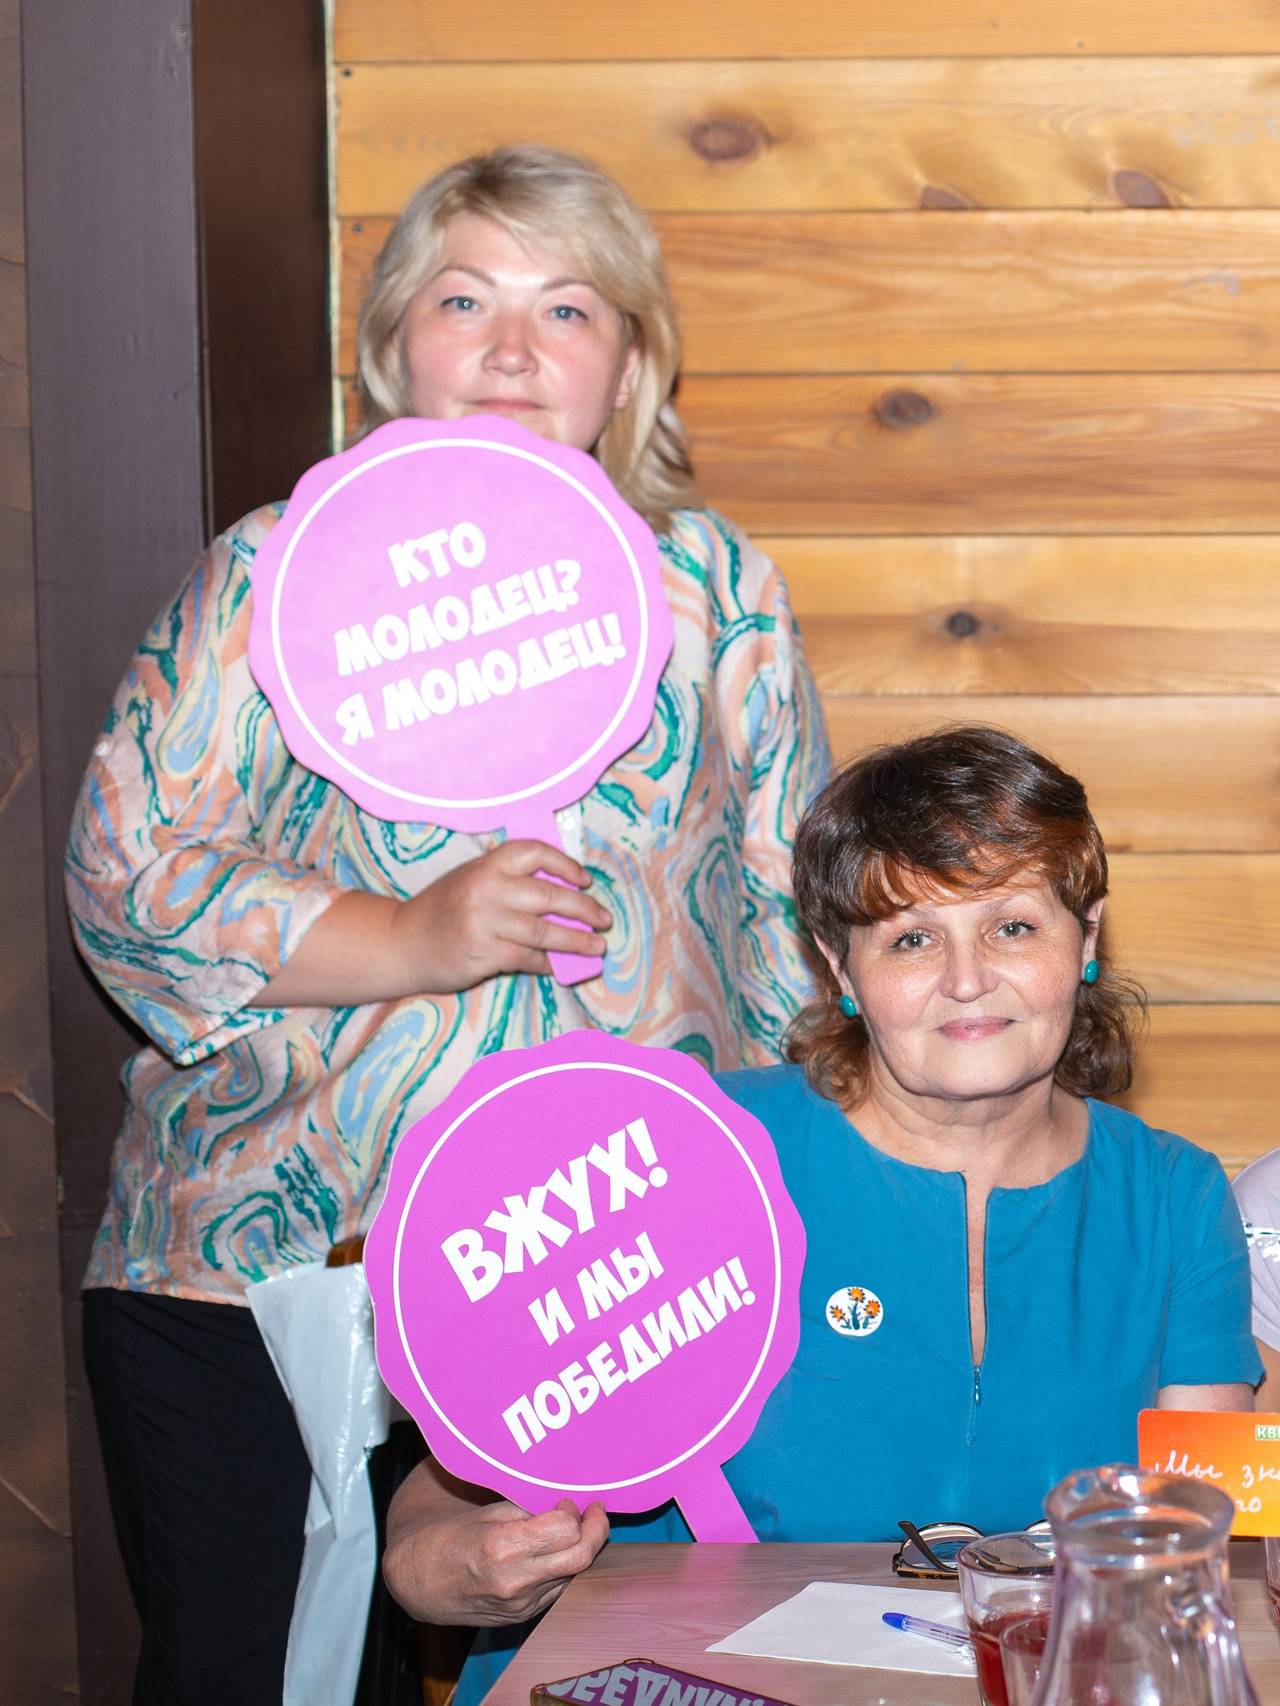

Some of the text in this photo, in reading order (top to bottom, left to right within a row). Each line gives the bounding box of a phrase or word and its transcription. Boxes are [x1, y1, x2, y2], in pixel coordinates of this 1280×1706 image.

[387, 522, 486, 588] КТО
[333, 559, 581, 676] МОЛОДЕЦ?
[335, 613, 627, 746] Я МОЛОДЕЦ!
[440, 1117, 668, 1303] ВЖУХ!
[527, 1231, 664, 1346] И МЫ
[501, 1255, 756, 1454] ПОБЕДИЛИ!
[1155, 1450, 1224, 1479] Мы
